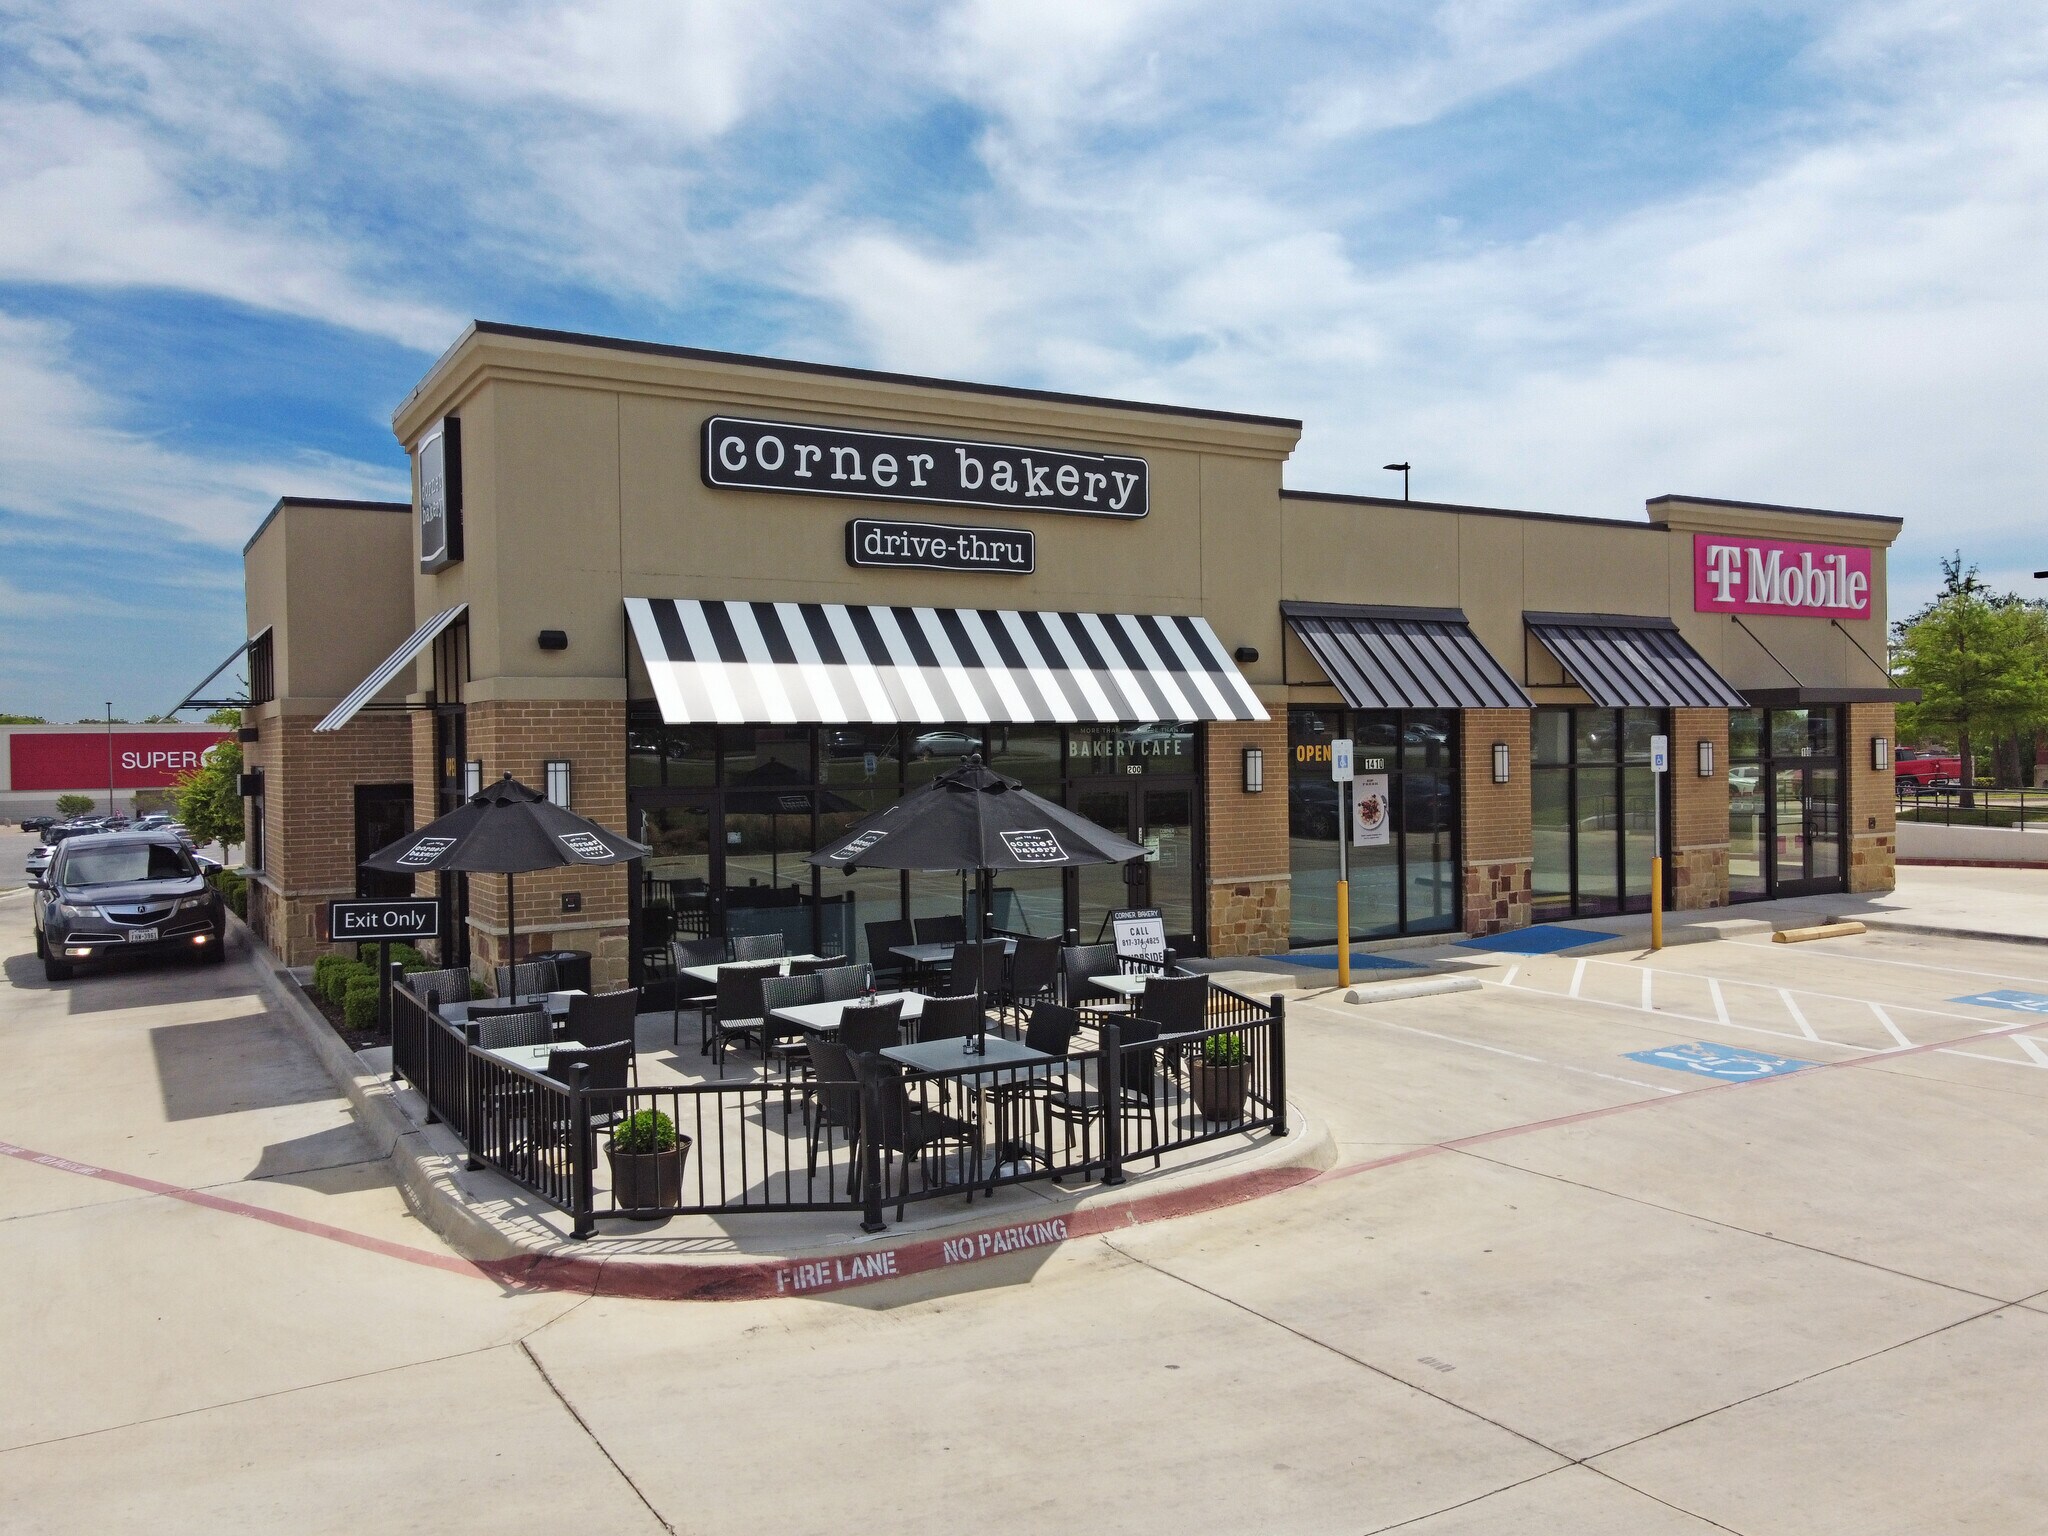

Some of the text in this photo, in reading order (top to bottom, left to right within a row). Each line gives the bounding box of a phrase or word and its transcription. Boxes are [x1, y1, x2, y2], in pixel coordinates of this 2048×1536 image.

[719, 435, 1139, 510] corner bakery
[864, 528, 1024, 563] drive-thru
[1744, 548, 1868, 610] Mobile
[1069, 740, 1182, 757] BAKERY CAFE
[1296, 745, 1332, 762] OPEN
[121, 751, 197, 769] SUPER
[1365, 758, 1385, 770] 1410
[1127, 765, 1142, 774] 200
[1013, 846, 1057, 854] bakery
[345, 910, 426, 930] Exit Only
[1114, 910, 1158, 919] CORNER BAKERY
[1129, 926, 1149, 936] CALL
[1125, 951, 1163, 962] BSIDE
[943, 1219, 1068, 1263] NO PARKING
[777, 1251, 897, 1293] FIRE LANE
